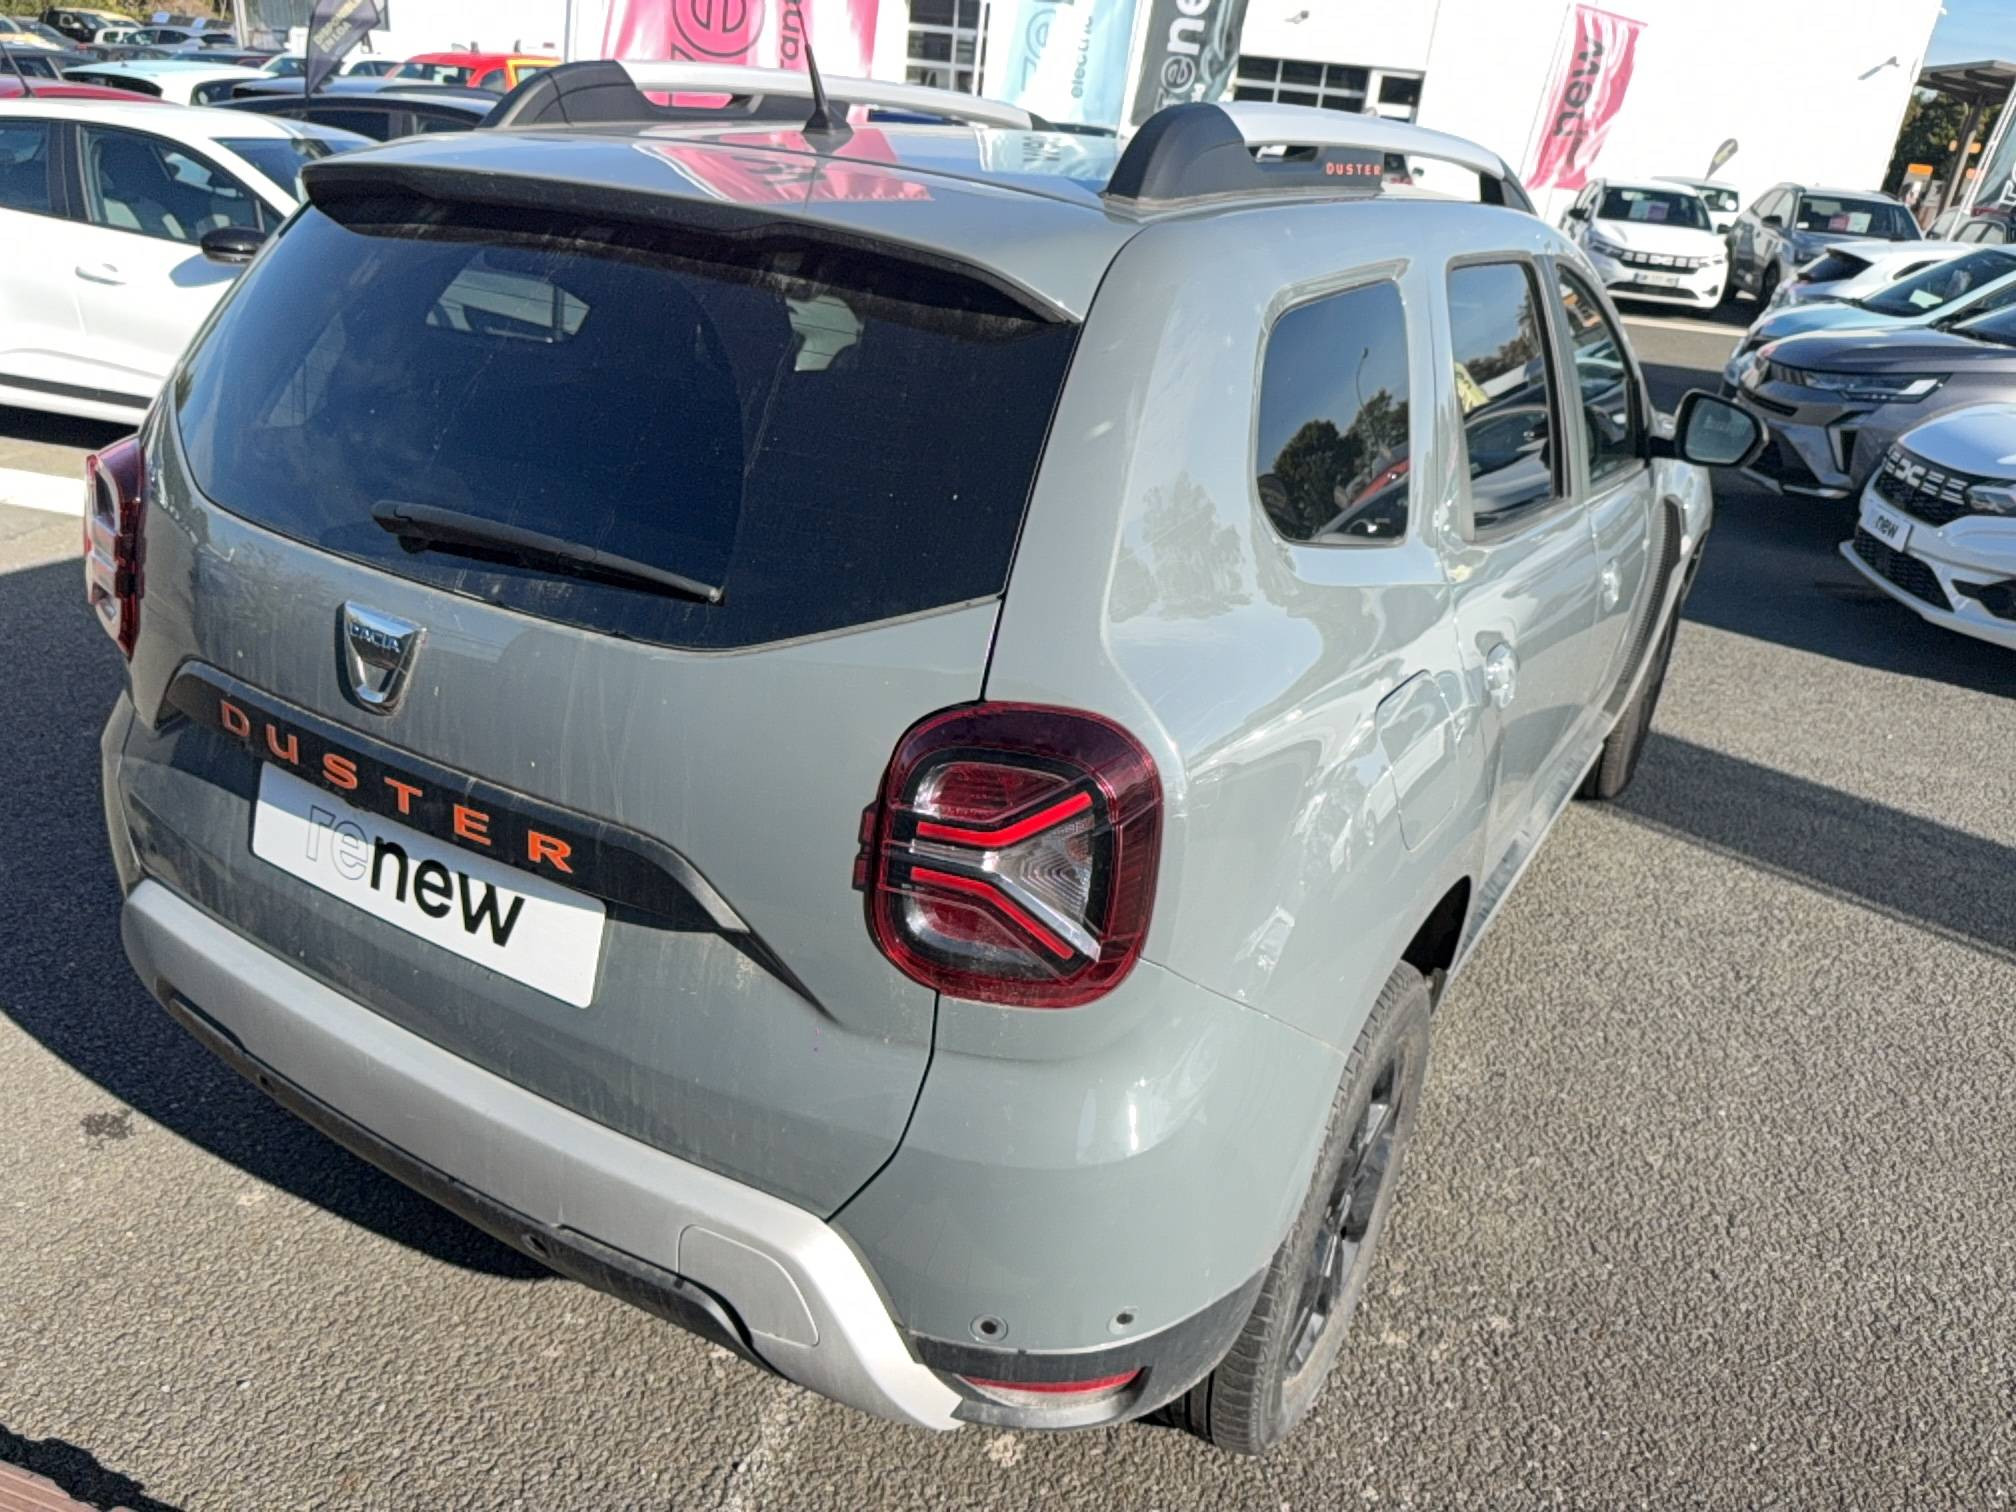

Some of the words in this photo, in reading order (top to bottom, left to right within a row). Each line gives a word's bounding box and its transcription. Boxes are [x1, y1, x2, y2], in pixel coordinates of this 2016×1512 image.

[1326, 161, 1381, 176] DUSTER
[349, 621, 401, 653] DACIA
[218, 699, 574, 874] DUSTER
[305, 804, 526, 948] renew
